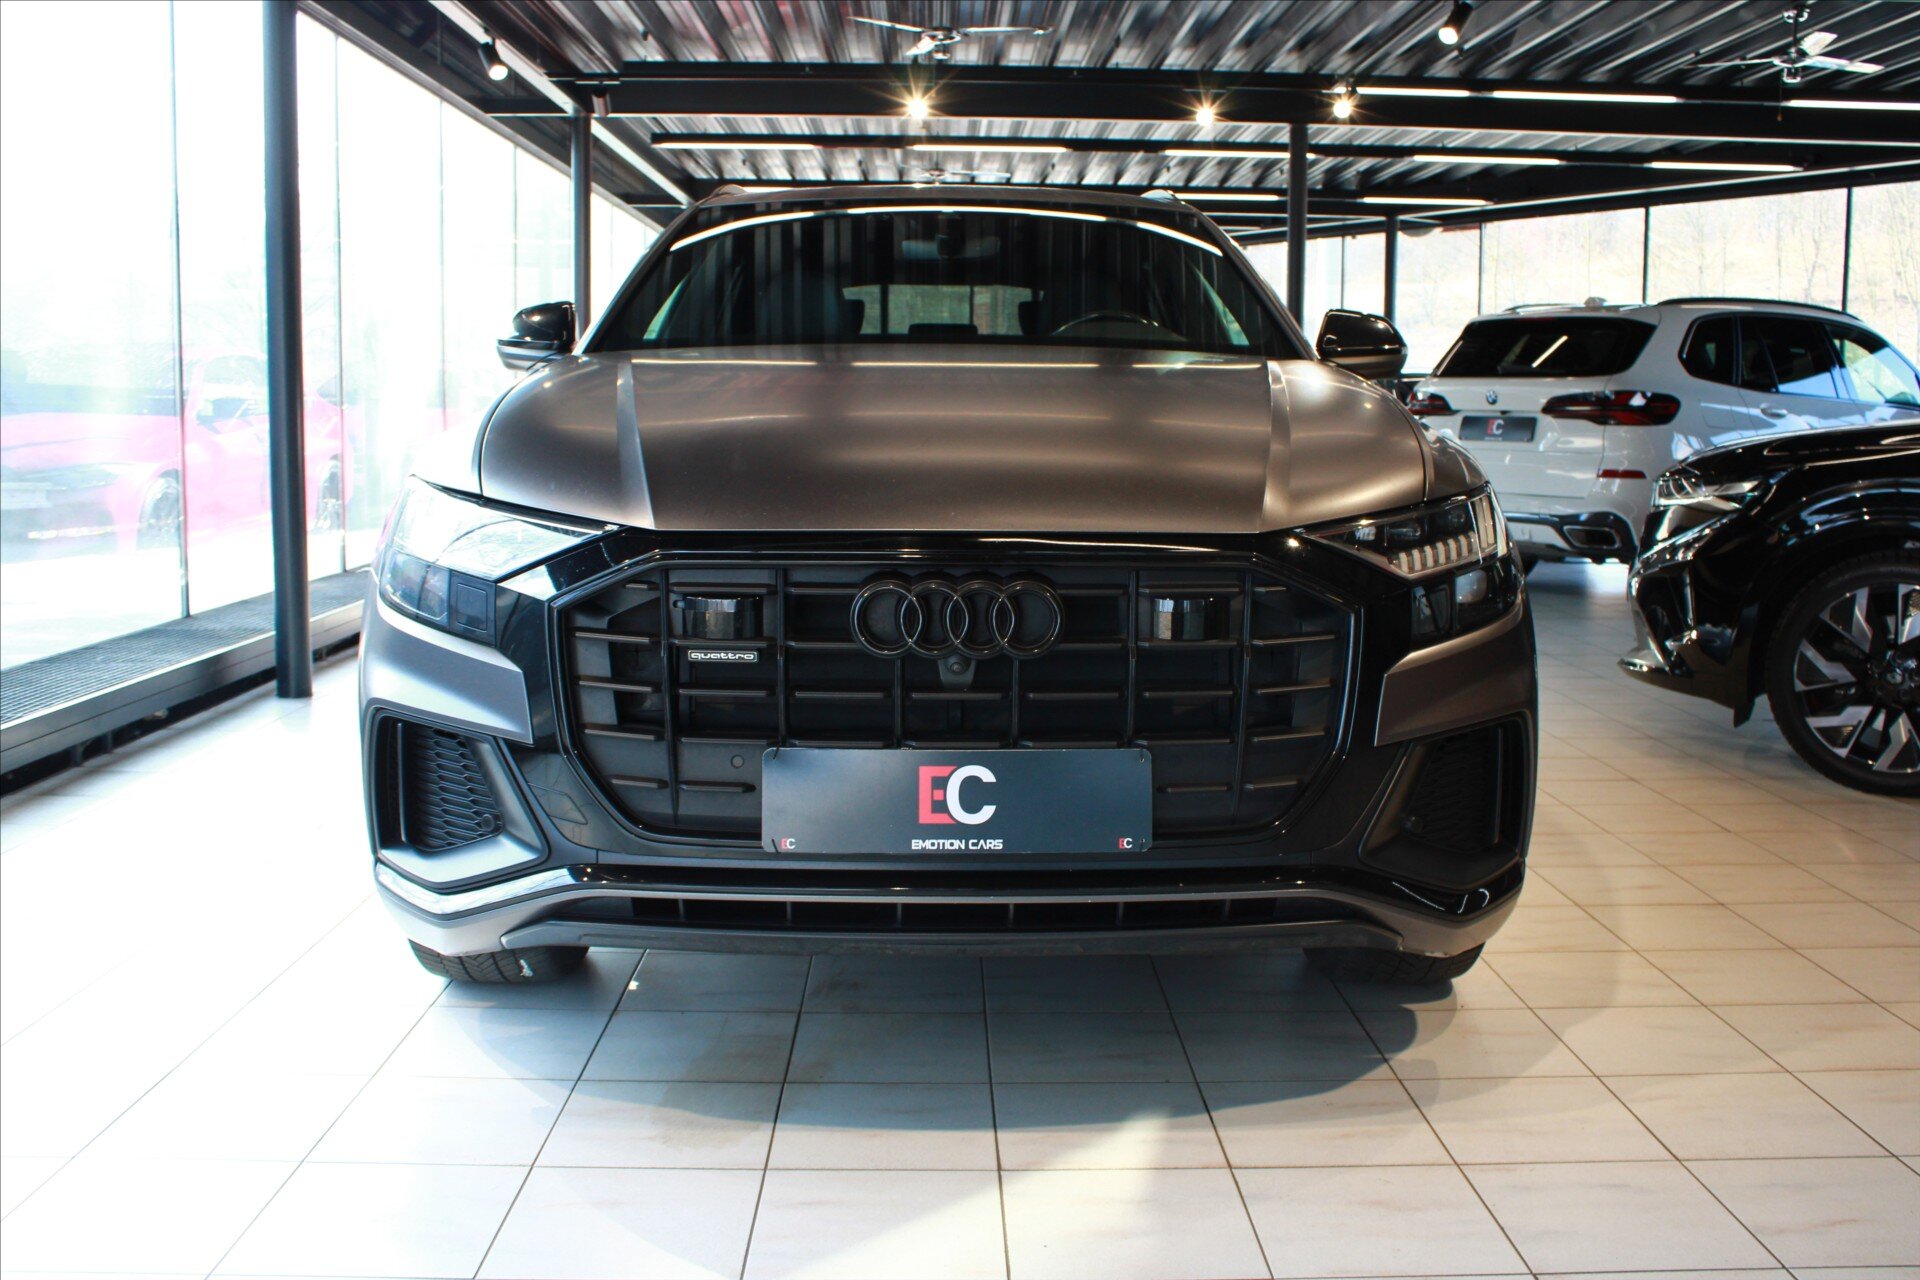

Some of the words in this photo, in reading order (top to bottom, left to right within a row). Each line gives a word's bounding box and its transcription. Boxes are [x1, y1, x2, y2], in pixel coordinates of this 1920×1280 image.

[691, 652, 754, 660] quattro
[918, 764, 997, 825] EC
[780, 838, 796, 849] EC
[911, 839, 965, 850] EMOTION
[968, 839, 1003, 850] CARS
[1118, 837, 1133, 849] EC
